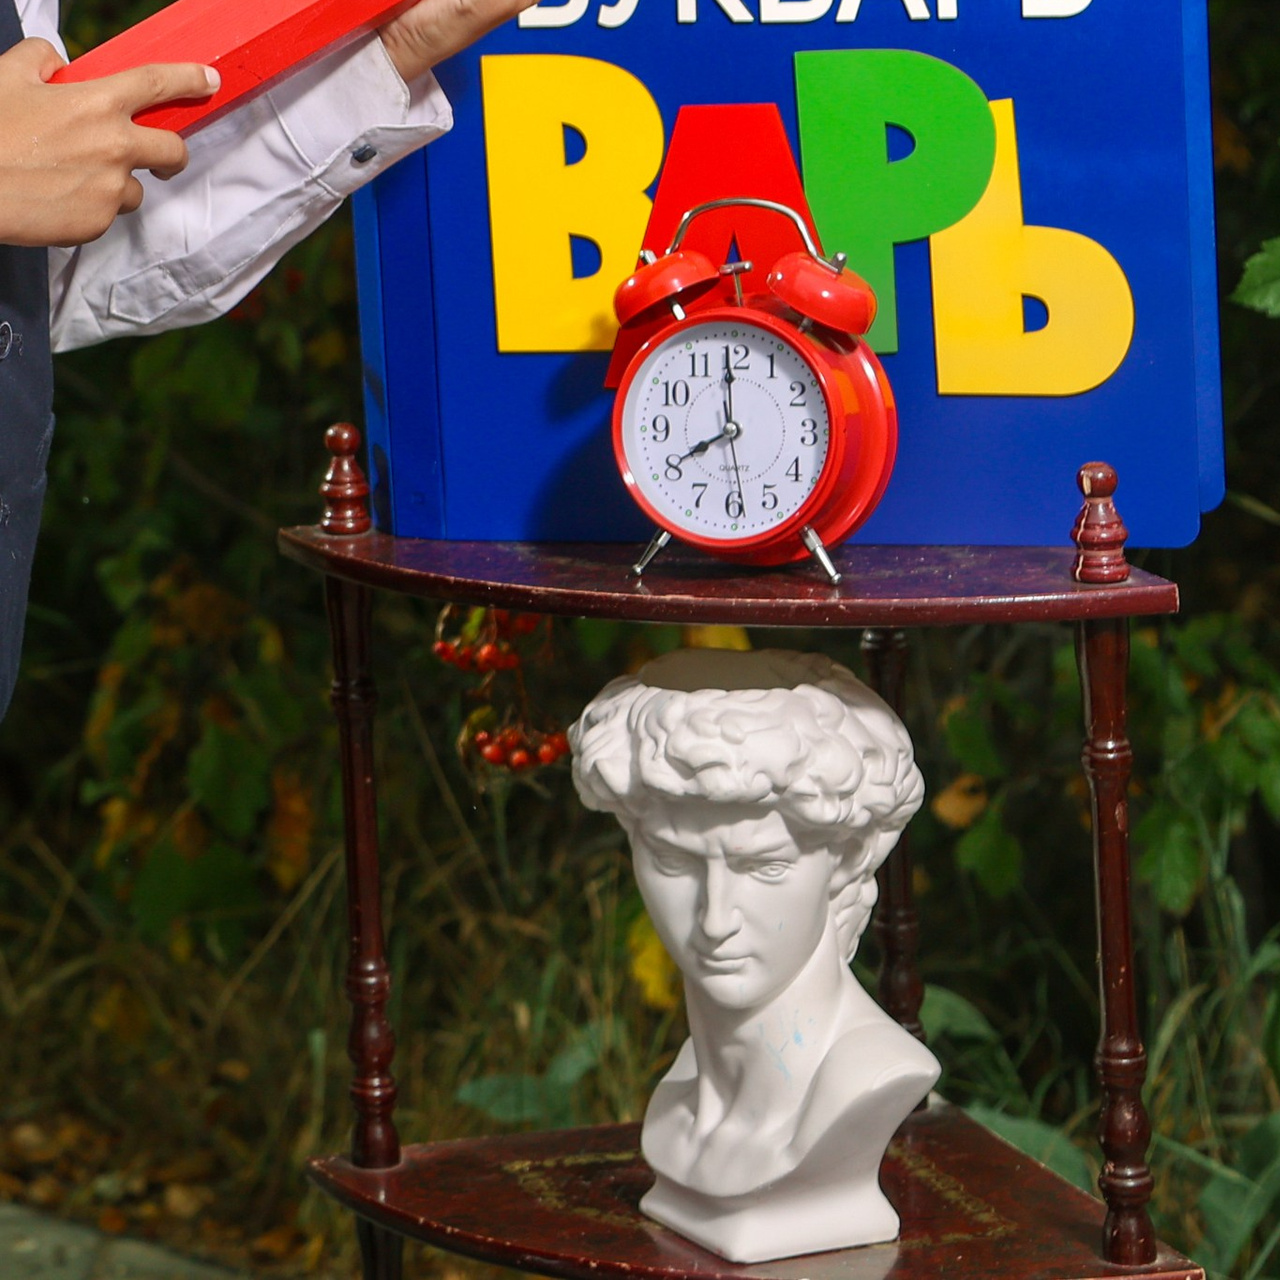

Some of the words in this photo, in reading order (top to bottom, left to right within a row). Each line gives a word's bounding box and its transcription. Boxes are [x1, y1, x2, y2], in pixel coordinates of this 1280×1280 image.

[480, 48, 1135, 397] ВАРЬ
[688, 352, 712, 378] 11
[722, 344, 750, 370] 12
[766, 353, 778, 379] 1
[662, 379, 690, 407] 10
[789, 381, 807, 407] 2
[652, 414, 670, 443] 9
[800, 418, 818, 446] 3
[664, 454, 682, 481] 8
[719, 464, 750, 472] QUARTZ
[785, 456, 803, 482] 4
[691, 482, 708, 508] 7
[725, 491, 744, 518] 6
[761, 484, 779, 510] 5
